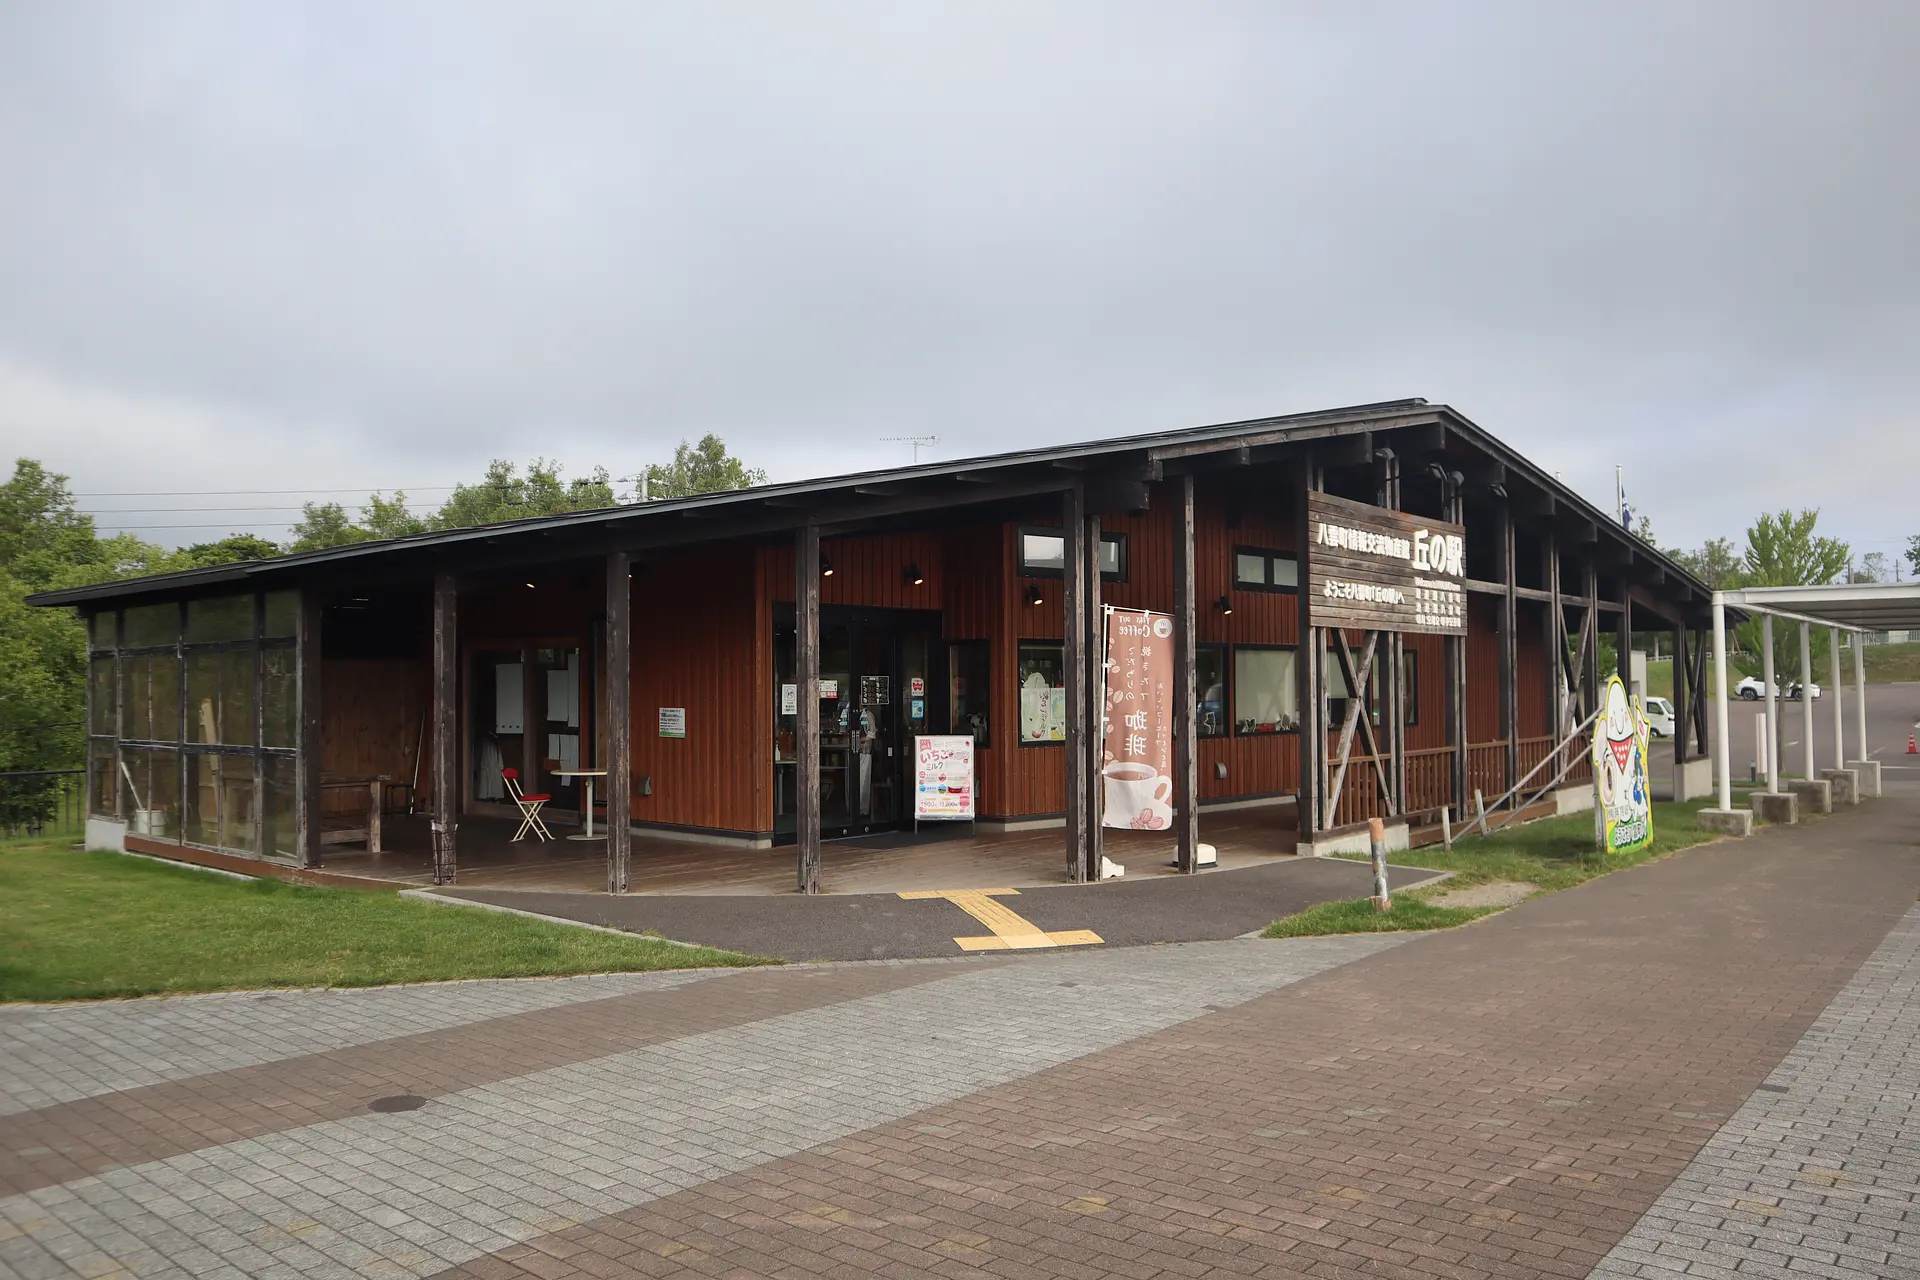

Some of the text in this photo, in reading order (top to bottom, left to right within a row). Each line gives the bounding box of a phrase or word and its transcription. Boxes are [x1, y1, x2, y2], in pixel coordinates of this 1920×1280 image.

[1412, 529, 1463, 577] 丘の駅
[926, 762, 943, 771] ミルク
